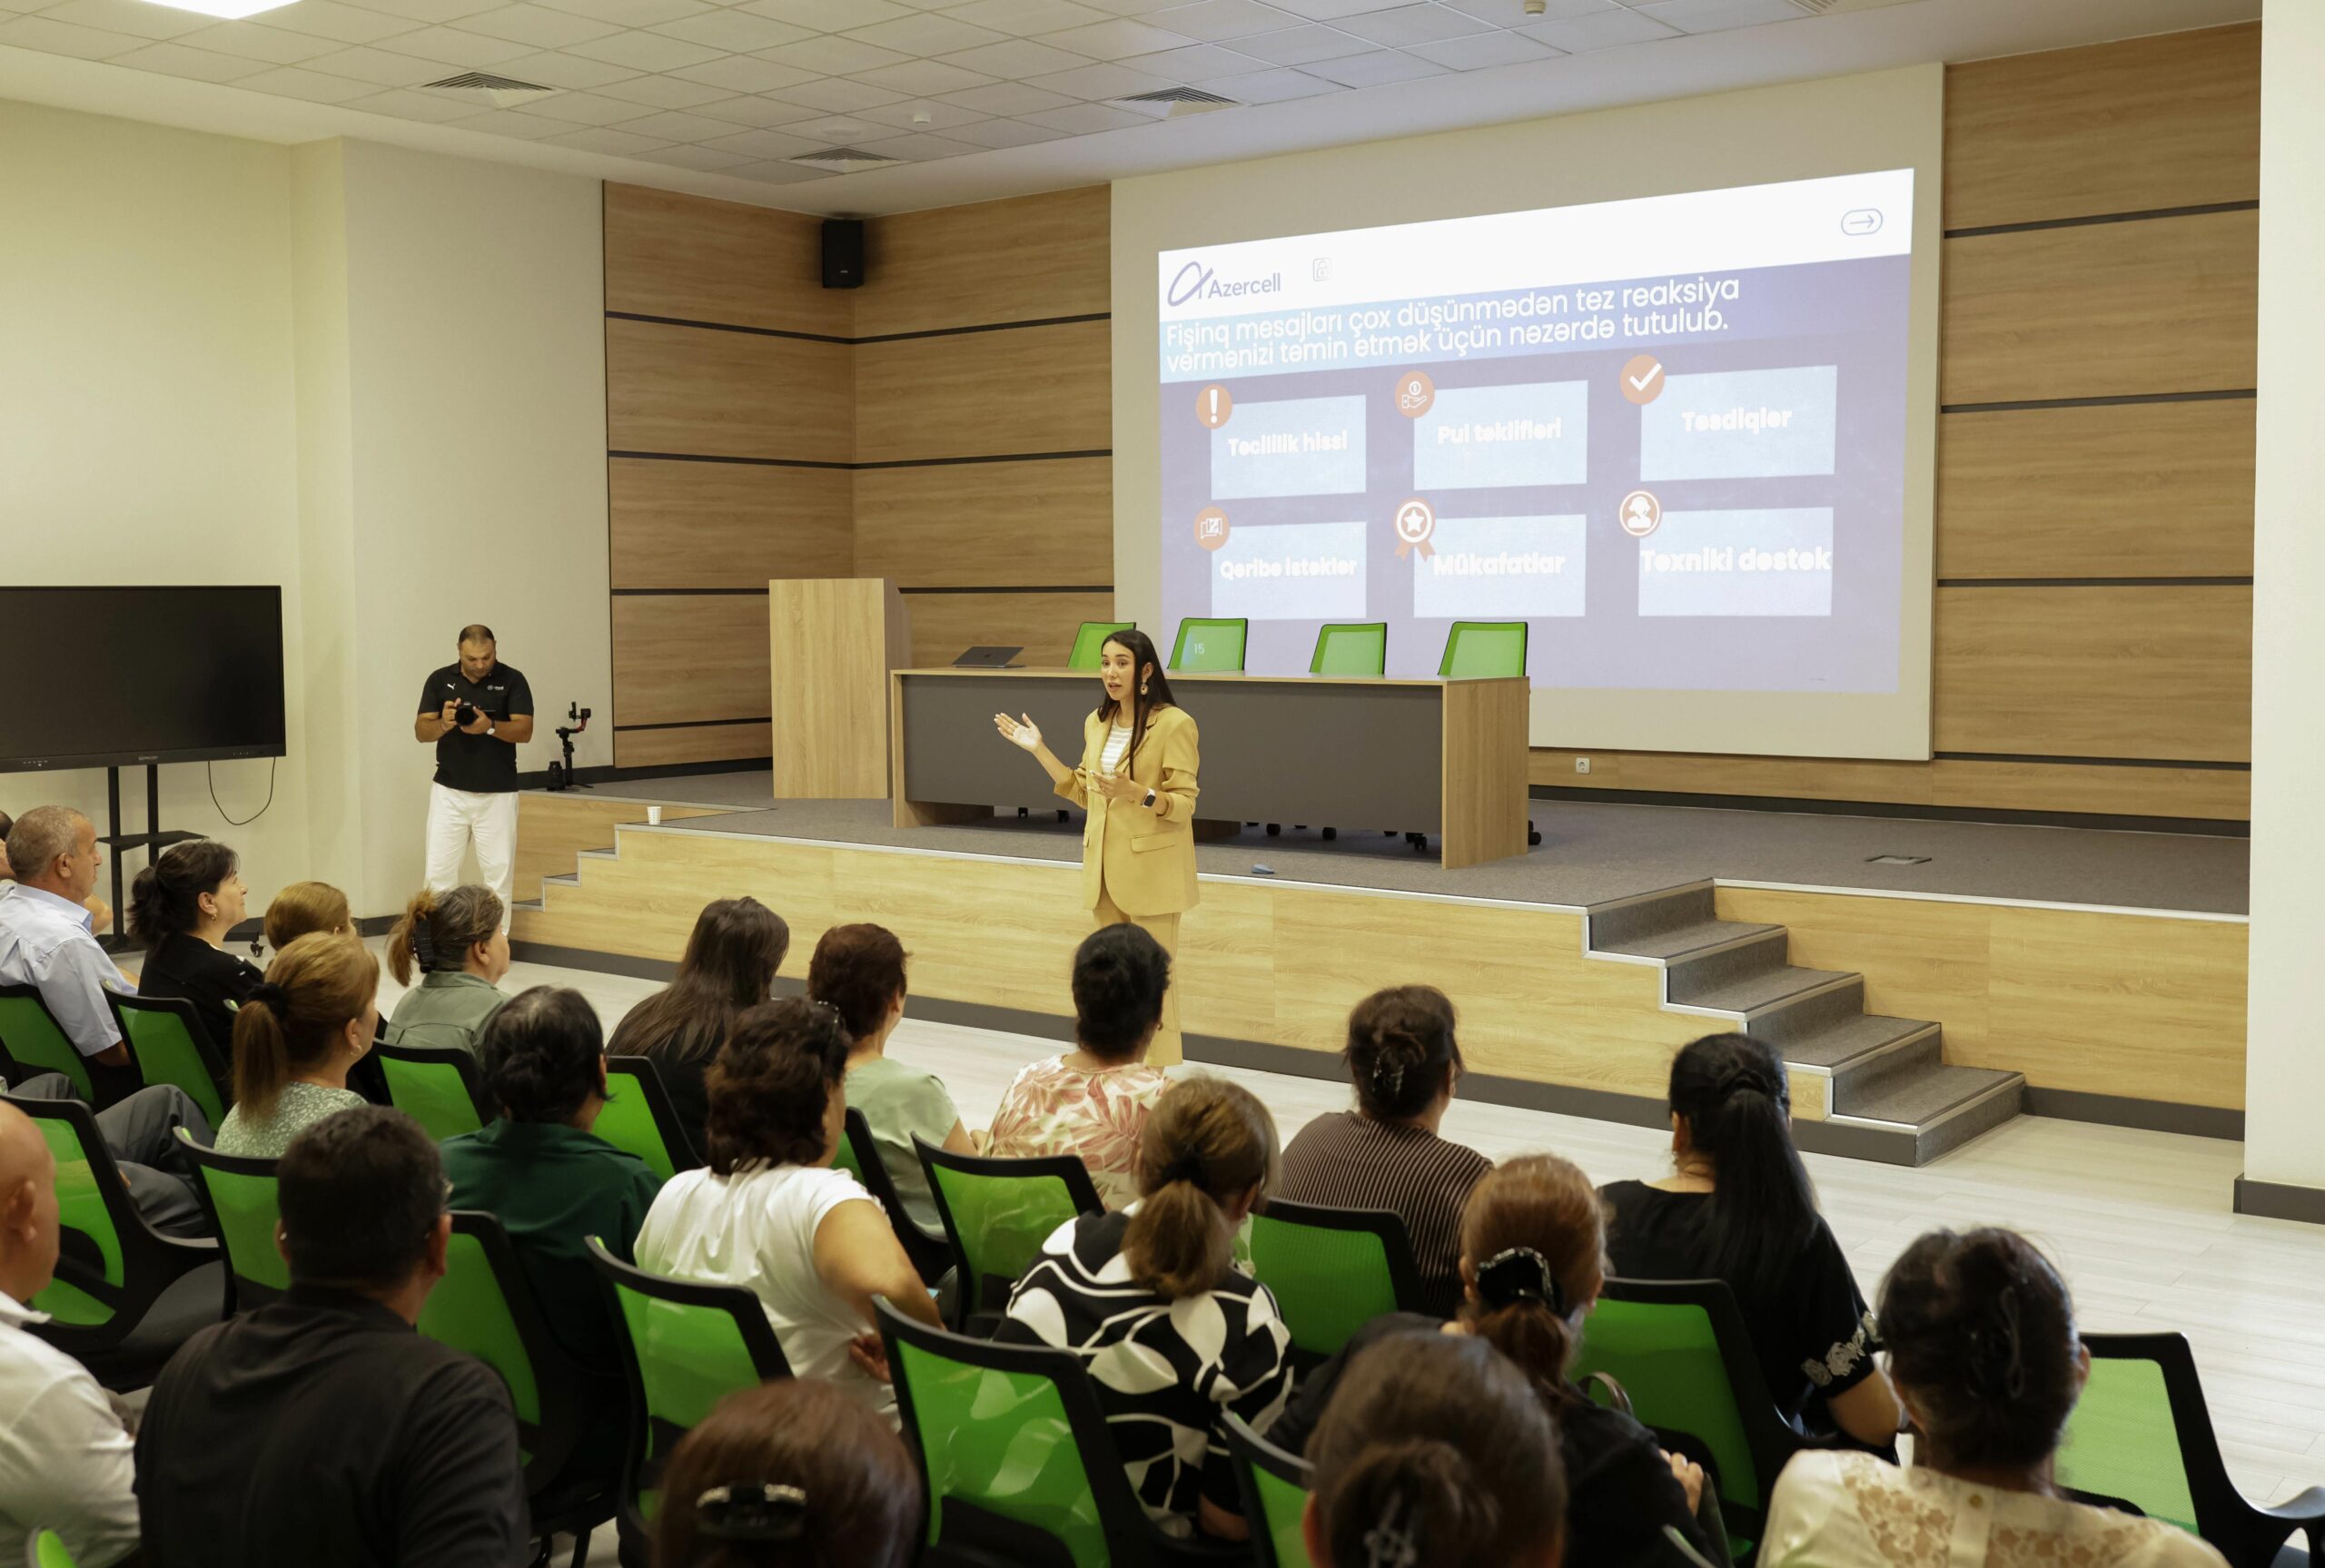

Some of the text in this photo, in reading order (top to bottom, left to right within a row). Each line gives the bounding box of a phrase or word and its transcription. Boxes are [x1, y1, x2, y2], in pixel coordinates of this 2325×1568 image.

[1208, 272, 1281, 299] Azercell
[1166, 276, 1739, 352] Fişinq mesajları çox düşünmədən tez reaksiya
[1280, 336, 1348, 363] təmin
[1354, 330, 1432, 358] etmək
[1438, 323, 1502, 356] üçün
[1510, 315, 1615, 345] nəzərdə
[1622, 307, 1729, 336] tutulub.
[1193, 643, 1205, 655] 15
